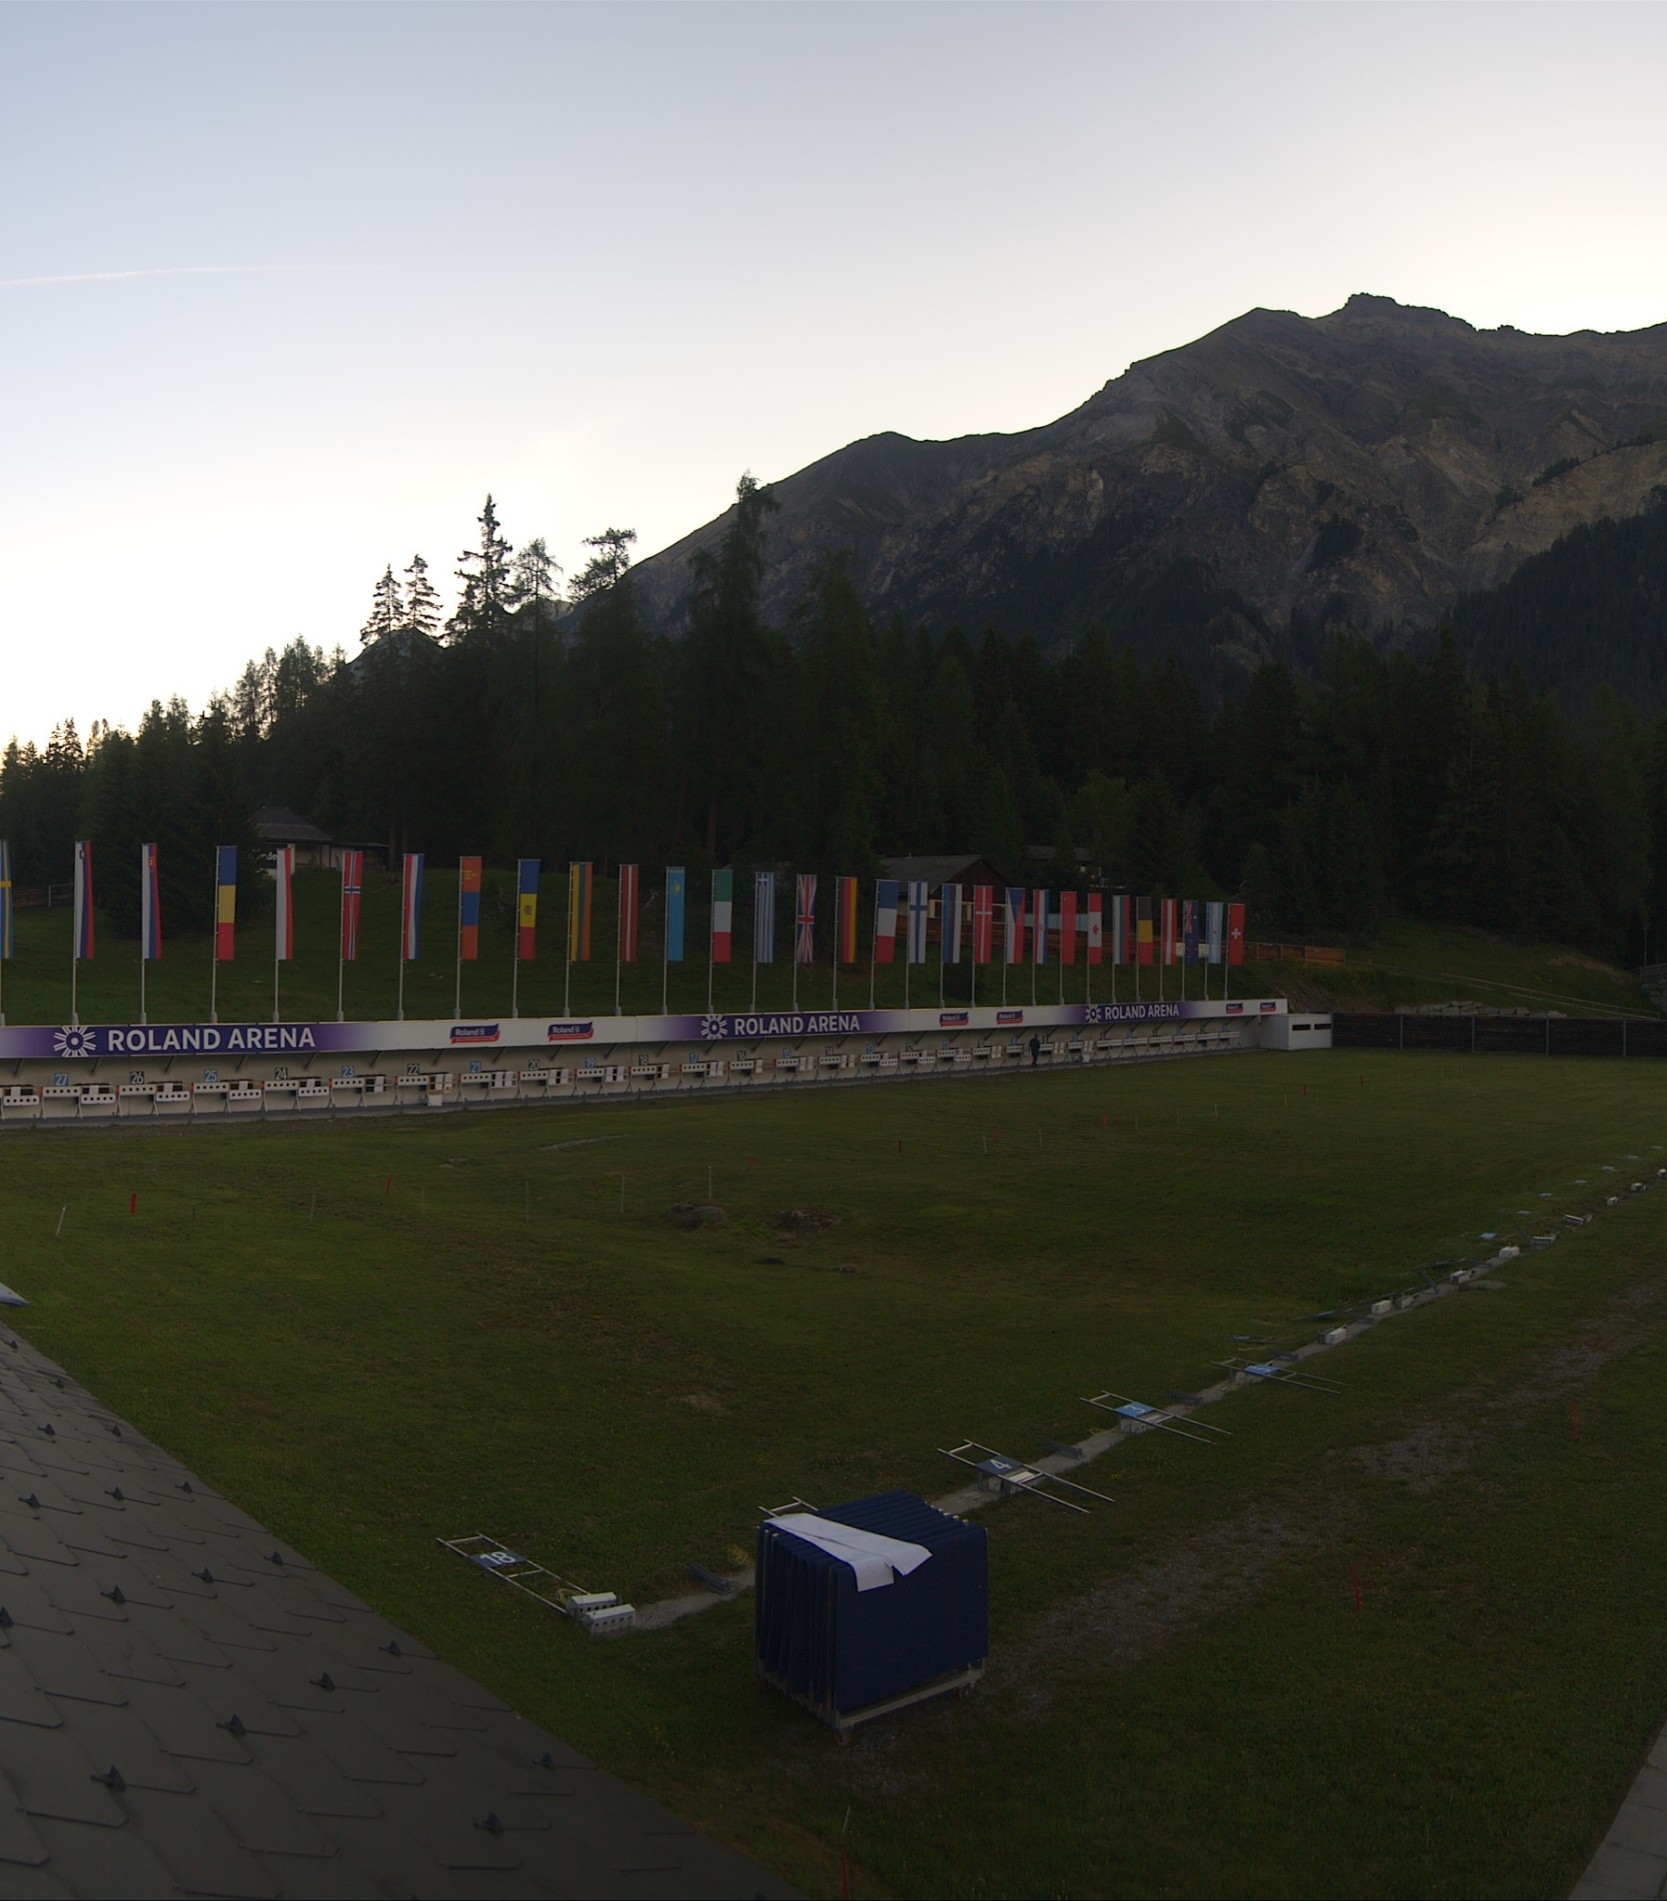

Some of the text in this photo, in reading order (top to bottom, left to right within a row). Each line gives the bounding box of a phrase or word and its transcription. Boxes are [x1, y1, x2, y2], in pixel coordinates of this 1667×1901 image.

[1104, 1003, 1180, 1020] ROLAND ARENA
[552, 1025, 575, 1034] Roland
[734, 1014, 861, 1036] ROLAND ARENA
[455, 1027, 480, 1037] Roland
[107, 1027, 316, 1052] ROLAND ARENA
[275, 1068, 288, 1080] 24
[342, 1065, 354, 1078] 23
[407, 1063, 419, 1074] 22
[55, 1072, 68, 1086] 27
[131, 1071, 144, 1084] 26
[204, 1069, 217, 1082] 25
